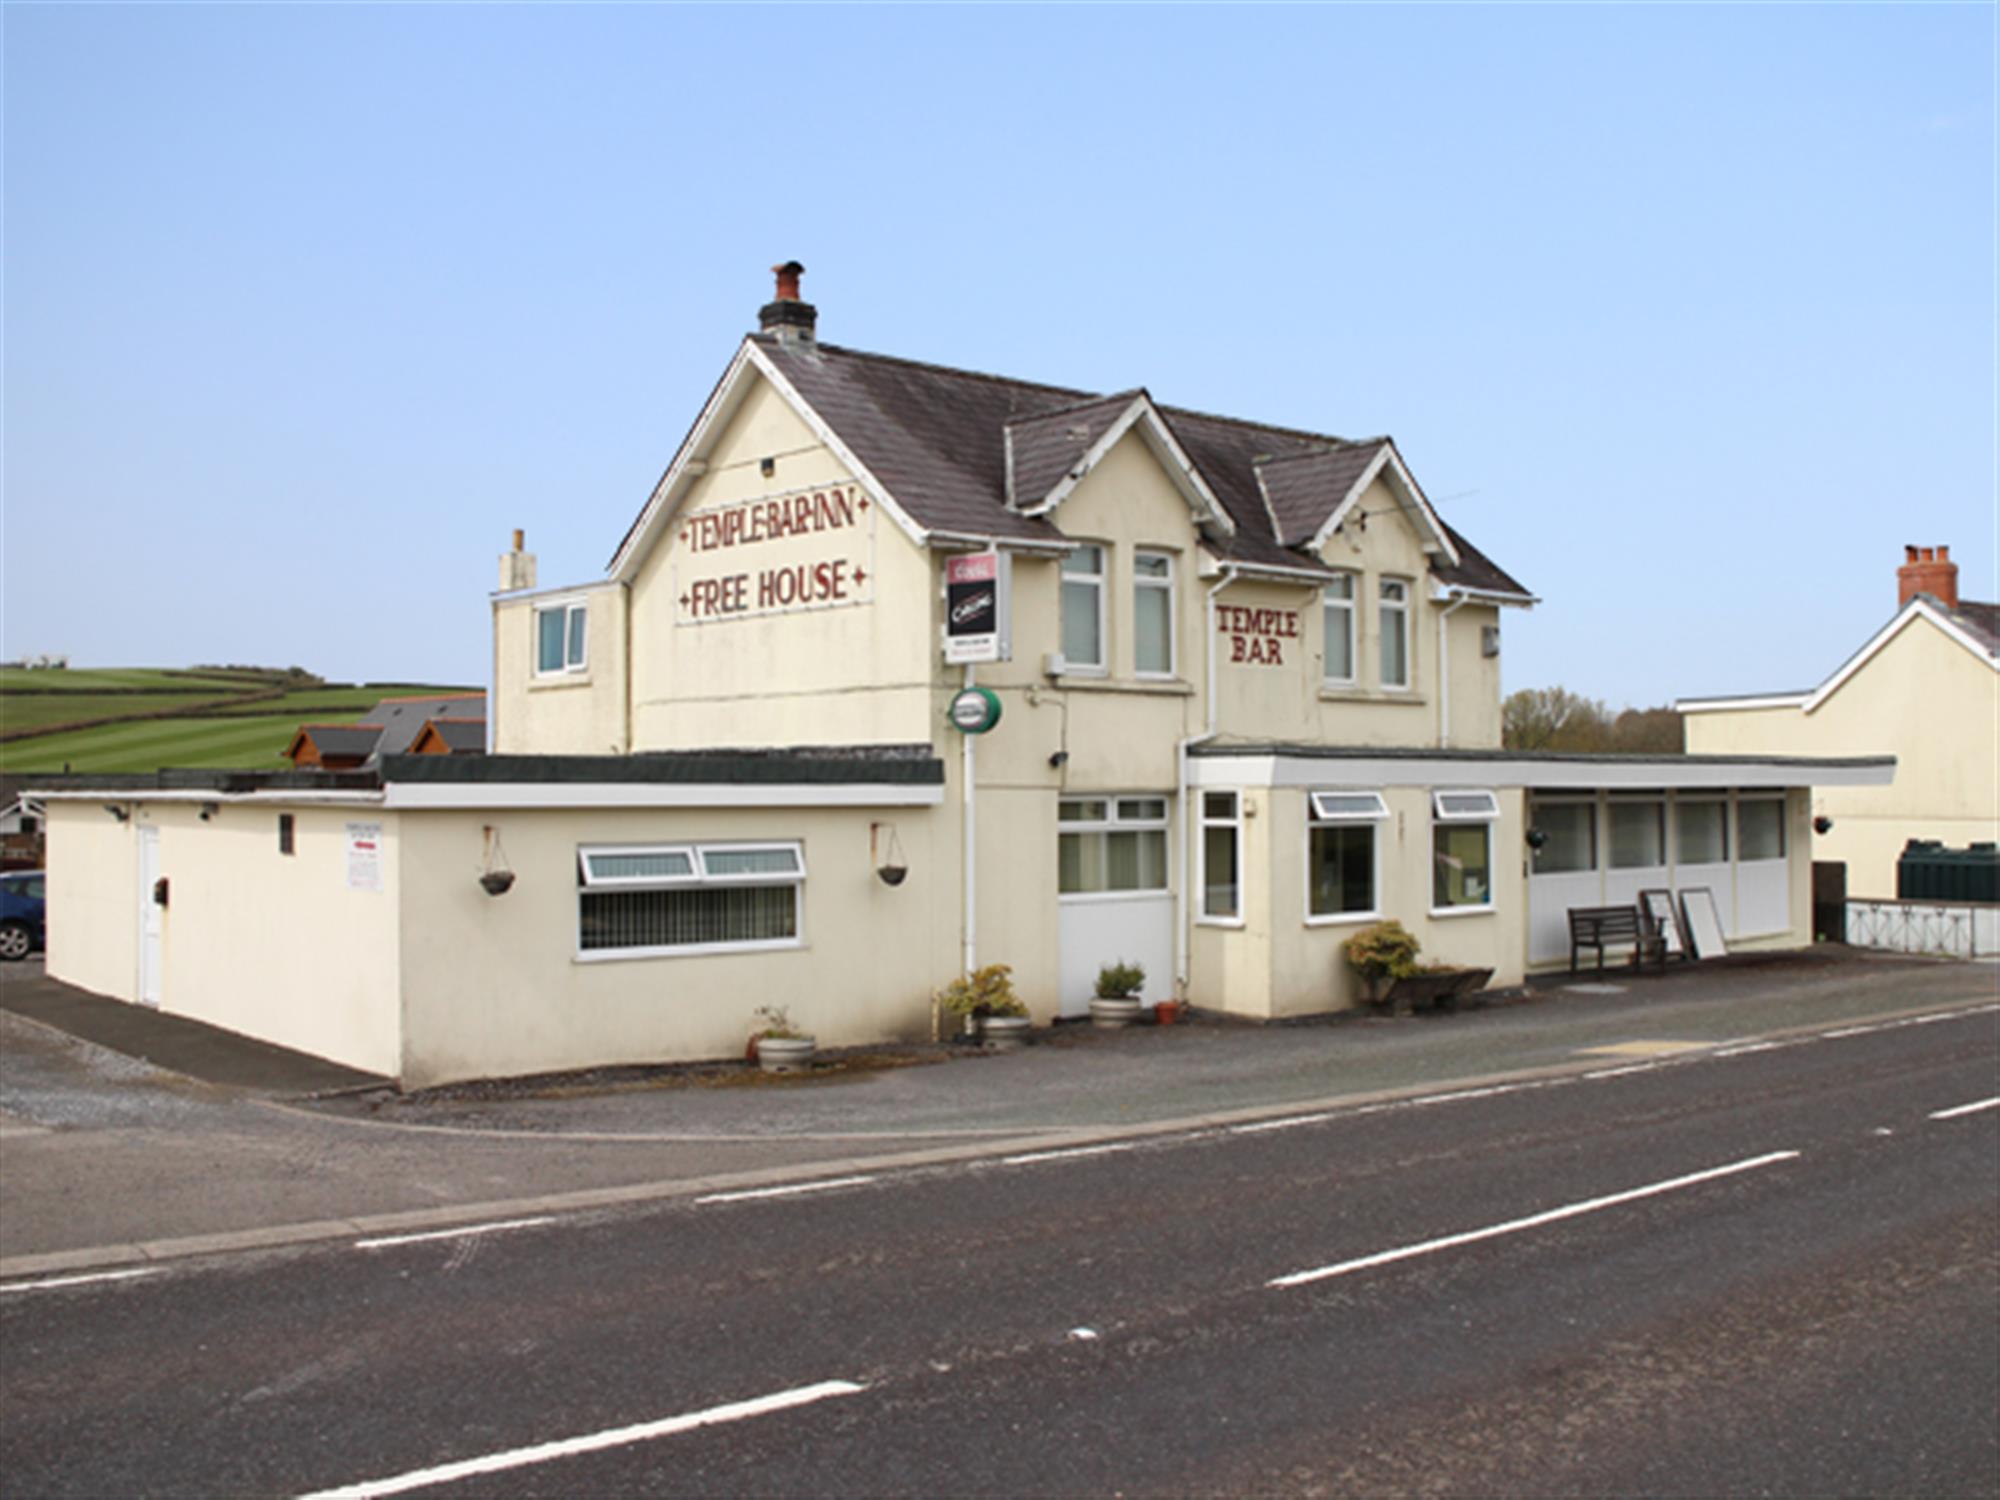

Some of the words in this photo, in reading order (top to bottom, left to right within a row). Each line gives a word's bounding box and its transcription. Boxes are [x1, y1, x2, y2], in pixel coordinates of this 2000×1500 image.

[691, 574, 749, 616] FREE
[758, 560, 847, 607] HOUSE
[1216, 605, 1298, 637] TEMPLE
[1231, 636, 1282, 666] BAR
